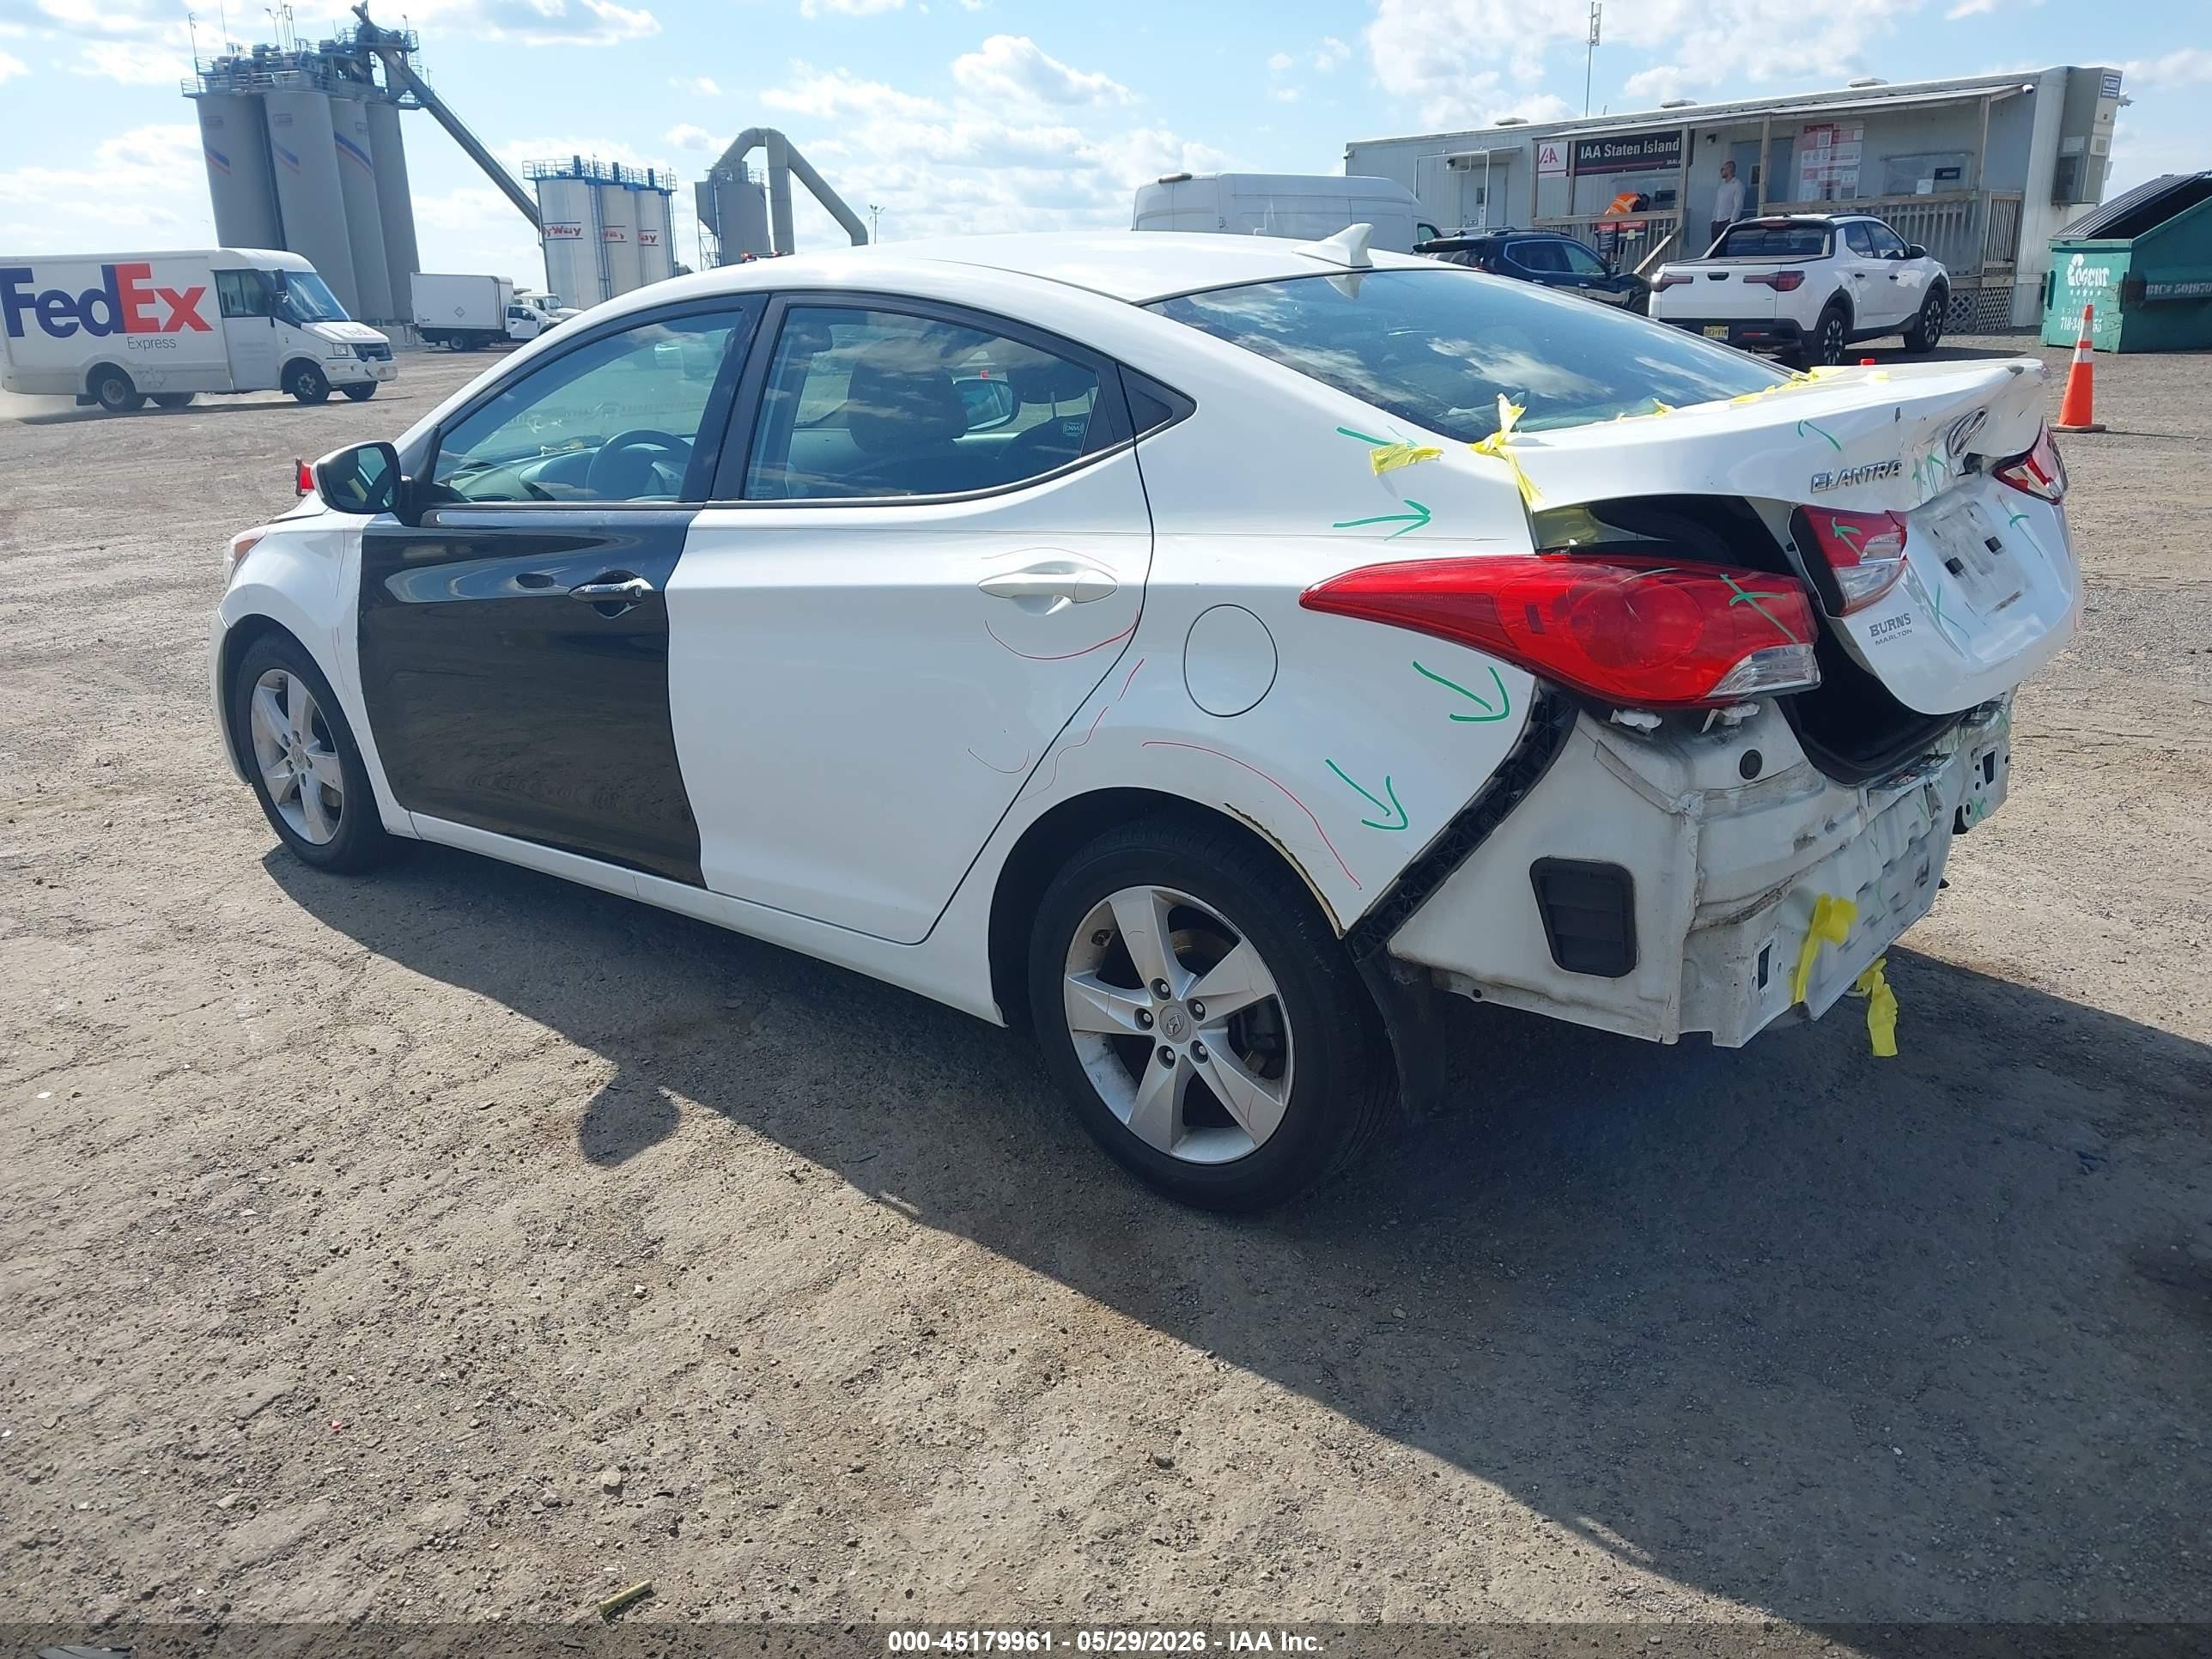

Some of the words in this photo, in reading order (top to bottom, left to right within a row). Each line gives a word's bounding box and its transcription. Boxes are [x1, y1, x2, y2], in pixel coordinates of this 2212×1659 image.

[1580, 144, 1601, 160] IAA
[1604, 142, 1640, 158] Staten
[1644, 137, 1680, 154] Island
[0, 263, 214, 338] FedEx
[126, 337, 177, 351] Express
[1810, 459, 1903, 494] ELANTRA
[1869, 612, 1911, 637] BURNS
[1875, 628, 1912, 646] MARLTON
